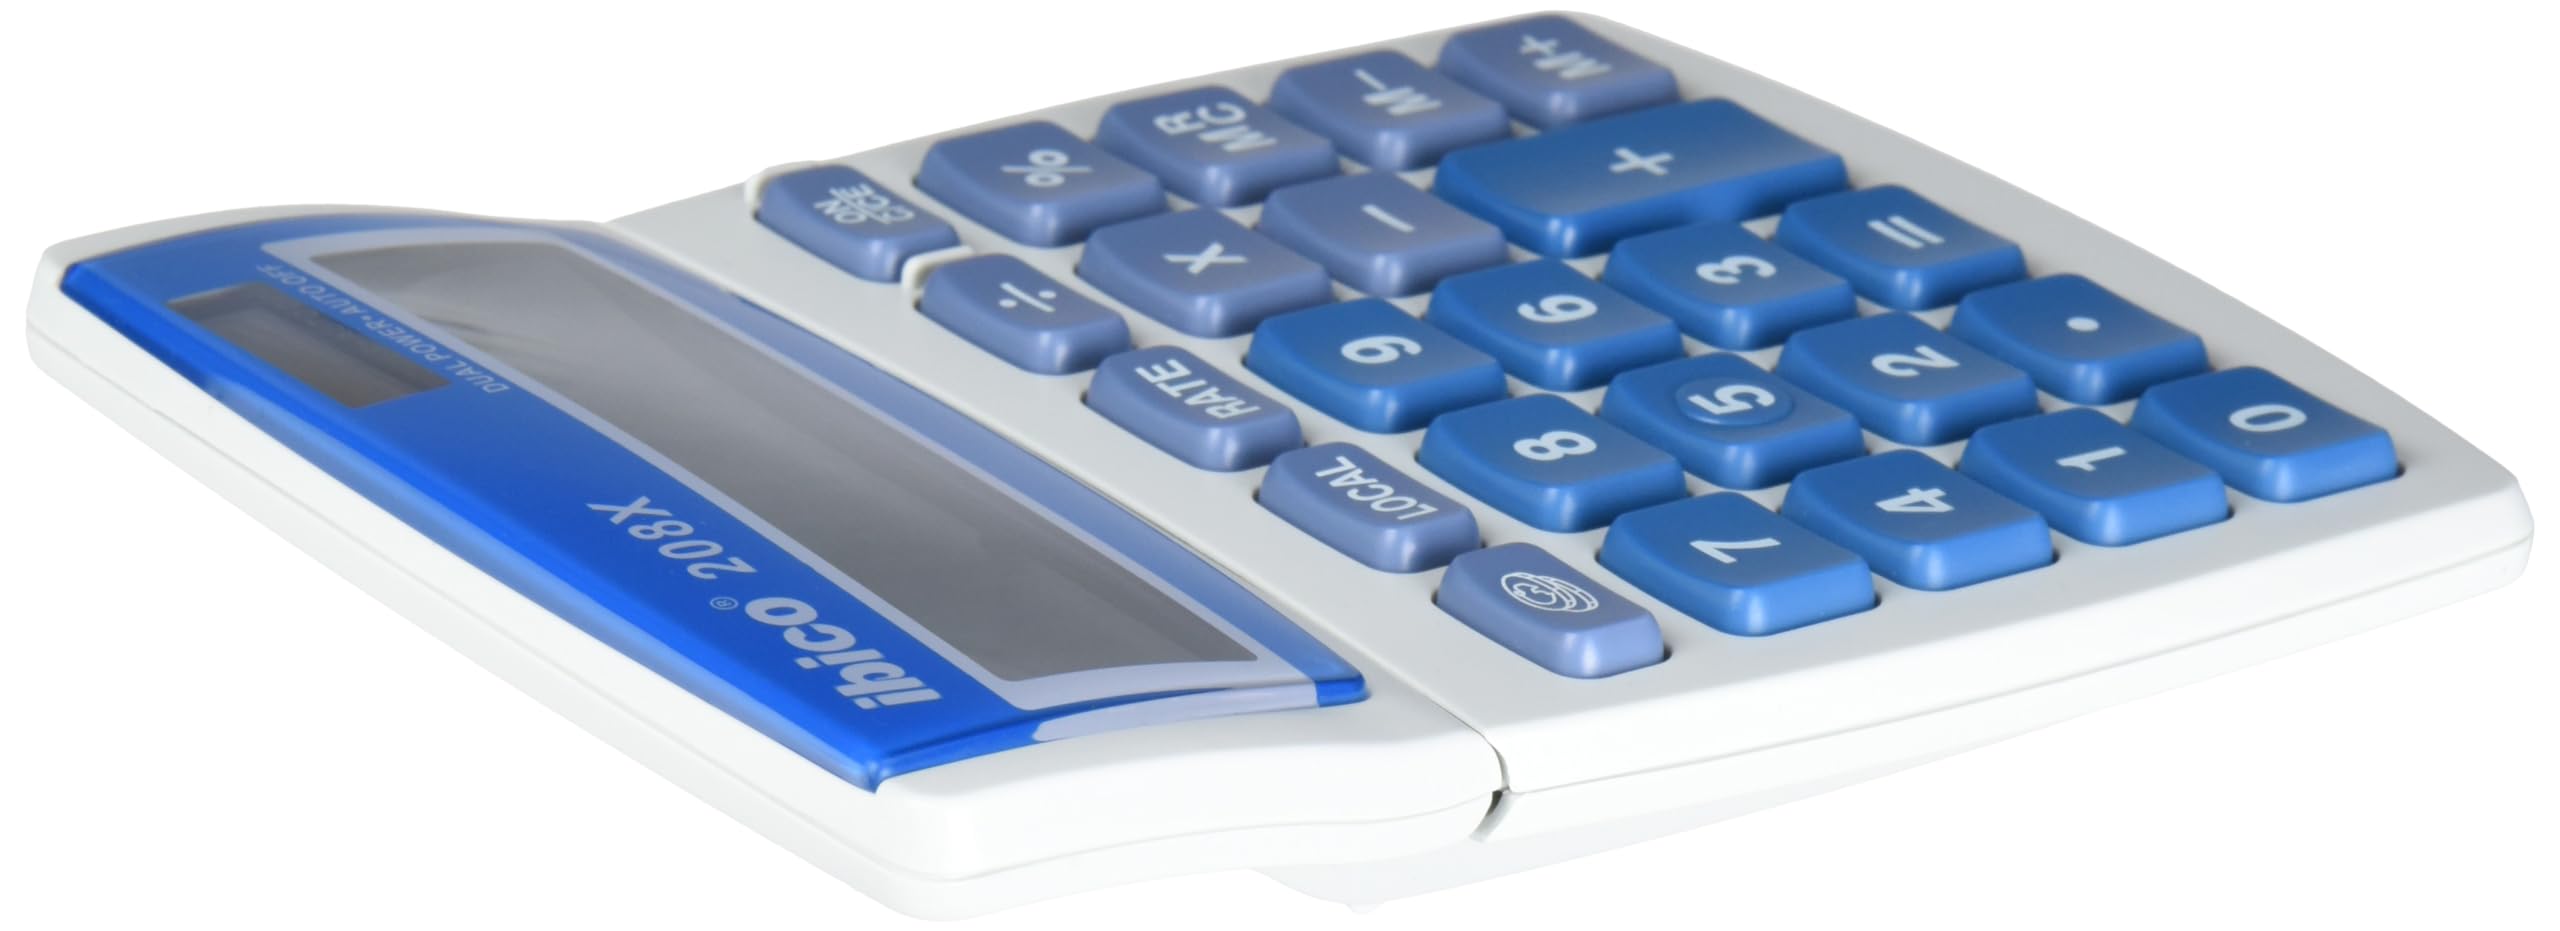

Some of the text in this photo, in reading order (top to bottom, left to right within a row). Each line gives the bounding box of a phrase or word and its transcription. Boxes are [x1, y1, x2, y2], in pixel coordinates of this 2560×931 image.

[1001, 149, 1091, 188] %
[256, 263, 307, 286] OFF
[1696, 256, 1777, 285] 3
[1517, 294, 1598, 323] 6
[1341, 335, 1422, 364] 9
[1871, 345, 1960, 377] 2
[444, 359, 511, 394] DUAL
[1135, 358, 1261, 420] RATE
[1687, 384, 1776, 415] 5
[1513, 430, 1597, 462] 8
[2056, 446, 2126, 472] 1
[1315, 455, 1439, 521] LOCAL
[1875, 486, 1954, 513] 4
[586, 495, 757, 580] 208X
[1689, 537, 1781, 564] 7
[745, 597, 942, 709] ibico
